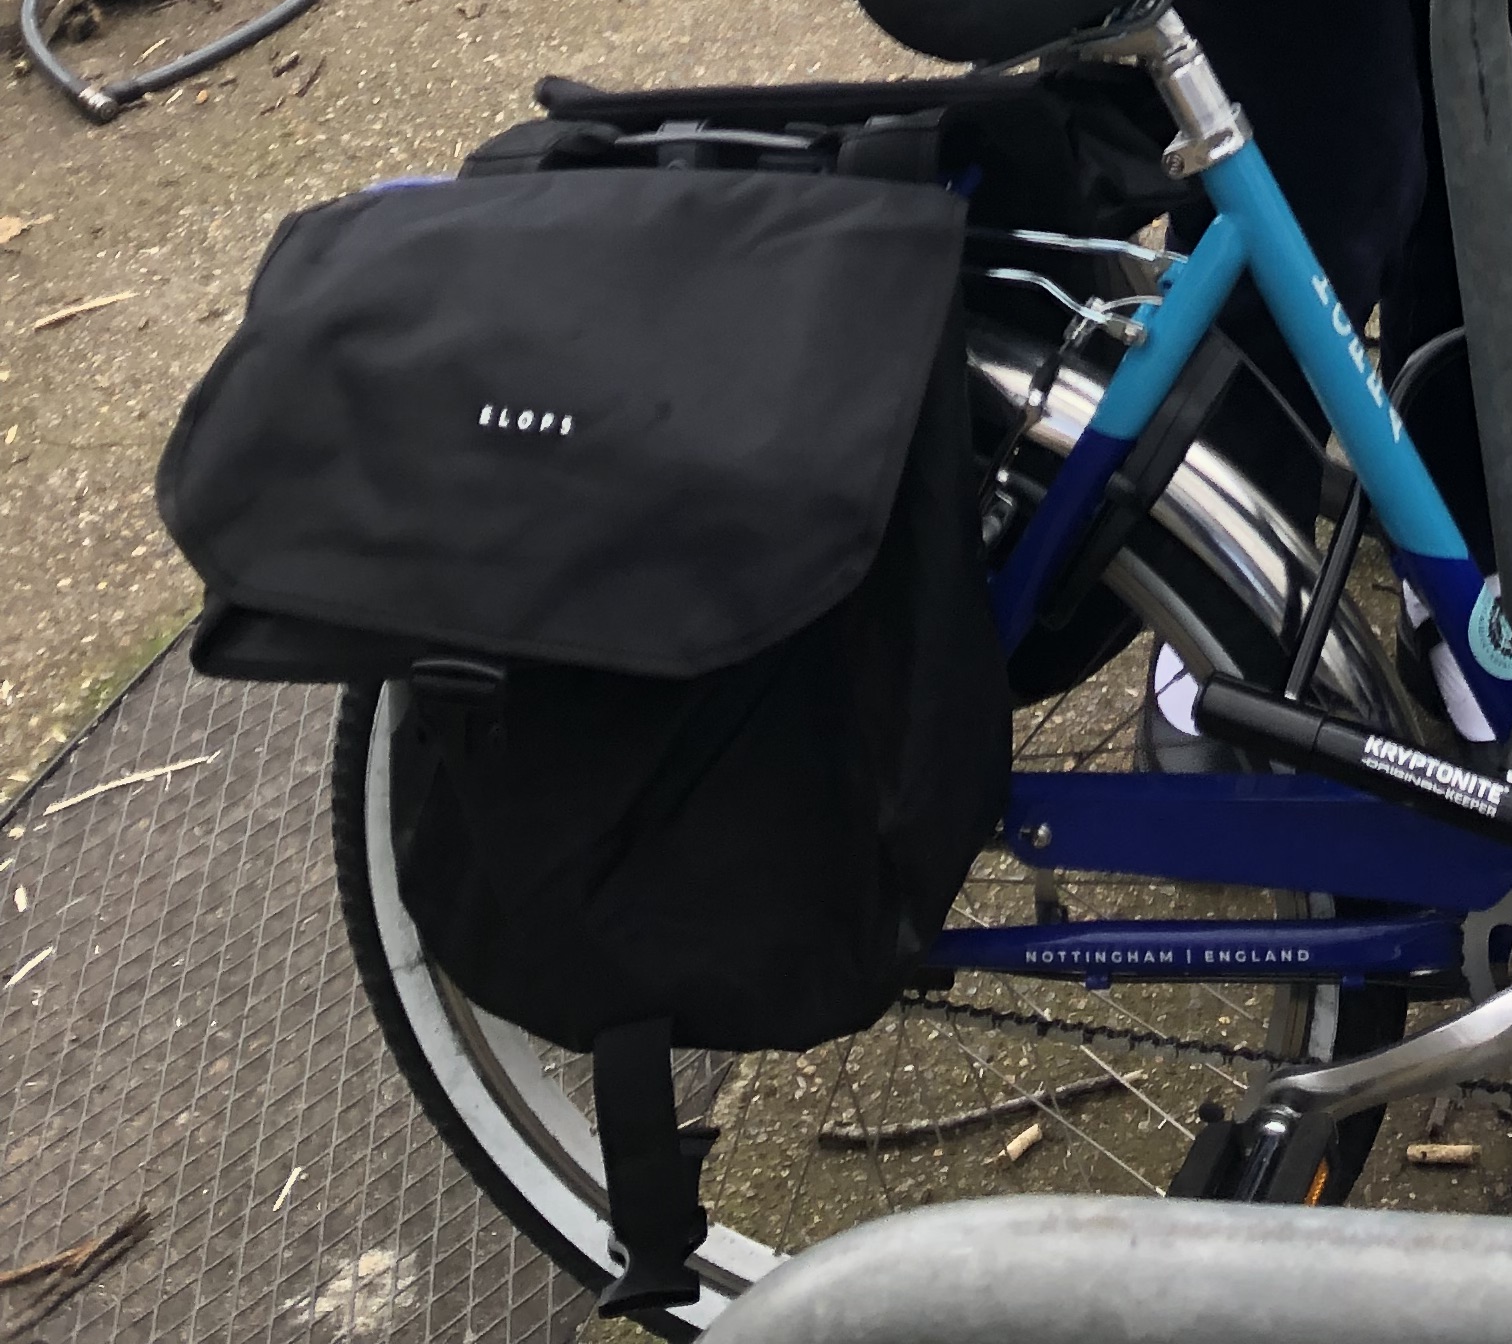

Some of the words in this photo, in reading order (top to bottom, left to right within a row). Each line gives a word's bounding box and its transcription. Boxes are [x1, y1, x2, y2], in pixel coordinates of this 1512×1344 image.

[1363, 734, 1505, 805] KRYPTONITE
[1025, 949, 1175, 964] NOTTINGHAM
[1204, 948, 1311, 963] ENGLAND
